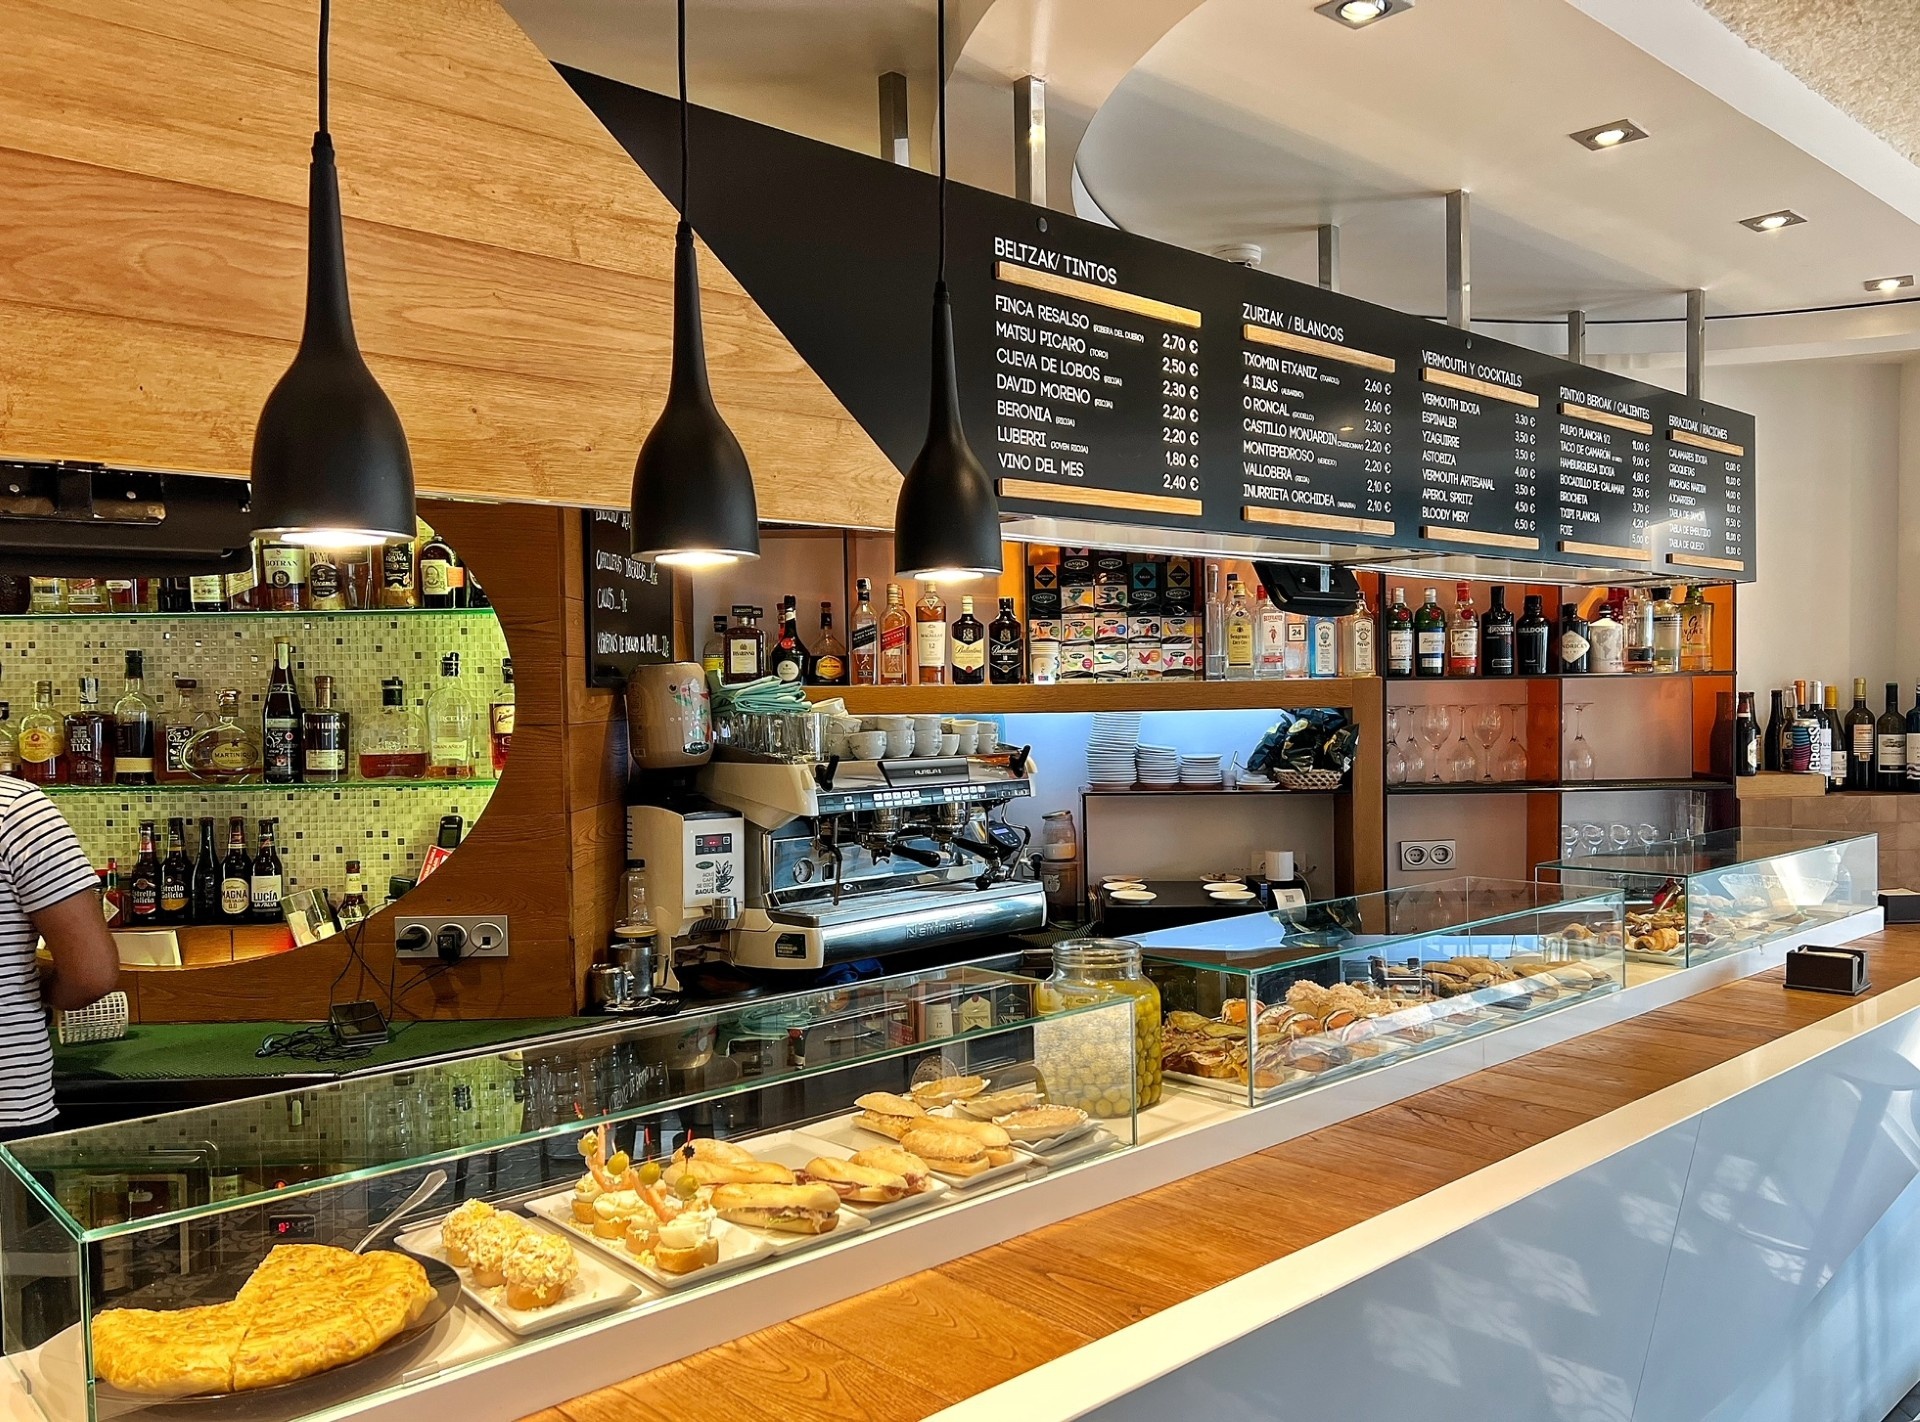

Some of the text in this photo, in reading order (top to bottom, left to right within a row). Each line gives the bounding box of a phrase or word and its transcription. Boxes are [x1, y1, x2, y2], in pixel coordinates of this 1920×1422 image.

[1063, 256, 1117, 284] TINTOS
[996, 294, 1034, 319] FINCA
[1038, 304, 1089, 329] RESALSO
[1162, 333, 1186, 352] 2,70
[1190, 340, 1198, 354] €
[1242, 303, 1284, 328] ZURIAK
[996, 322, 1036, 345] MATSU
[1040, 330, 1086, 354] PICARO
[1162, 357, 1186, 375] 2,50
[1190, 363, 1198, 376] €
[996, 348, 1198, 400] CUEVA DE LOBOS 2,30 €
[1243, 352, 1391, 395] TXOMIN ETXANIZ 2,60 €
[1422, 350, 1522, 388] VERMOUTH Y COCKTAILS
[996, 374, 1198, 423] DAVID MORENO 2,20 €
[1243, 374, 1391, 415] 4 ISLAS 2,60 €
[1422, 392, 1458, 411] VERMOUTH
[1460, 400, 1480, 415] IDOIA
[1560, 386, 1649, 420] PINTXO BEROAK CALIENTES
[997, 400, 1199, 446] BERONIA 2,20 €
[1243, 396, 1391, 435] O RONCAL 2,30 €
[1422, 411, 1528, 443] ESPINALER 3,50
[998, 426, 1199, 468] LUBERRI 1,80 €
[1243, 418, 1391, 455] CASTILLO MONJARDIN 2,20 €
[1422, 430, 1528, 461] YZAGUIRRE 3,50
[1560, 423, 1577, 437] PULPO
[1579, 429, 1602, 443] PLANCHA
[1560, 441, 1575, 453] TACO
[1577, 445, 1584, 454] DE
[998, 452, 1199, 492] VINO DEL MES 2,40 €
[1243, 441, 1391, 474] MONTEPEDROSO 2,20 €
[1422, 450, 1528, 478] ASTOBIZA 4,00
[1560, 458, 1598, 474] HAMBURGUESA
[1243, 462, 1391, 494] VALLOBERA 2,10 €
[1422, 469, 1528, 496] VERMOUTH ARTESANAL 3,50
[1560, 474, 1592, 489] BOCADILLO
[1593, 480, 1600, 490] DE
[1601, 483, 1625, 495] CALAMAR
[1243, 484, 1391, 513] INURRIETA ORCHIDEA 2,10 €
[1423, 488, 1528, 513] APEROL SPRITZ 4,50
[1560, 491, 1588, 505] BROCHETA
[1423, 507, 1528, 530] BLOODY MERY 6,50
[1576, 510, 1600, 523] PLANCHA
[266, 559, 298, 567] BOTRAN
[71, 744, 92, 752] TIKI
[253, 890, 278, 901] LUCÍA
